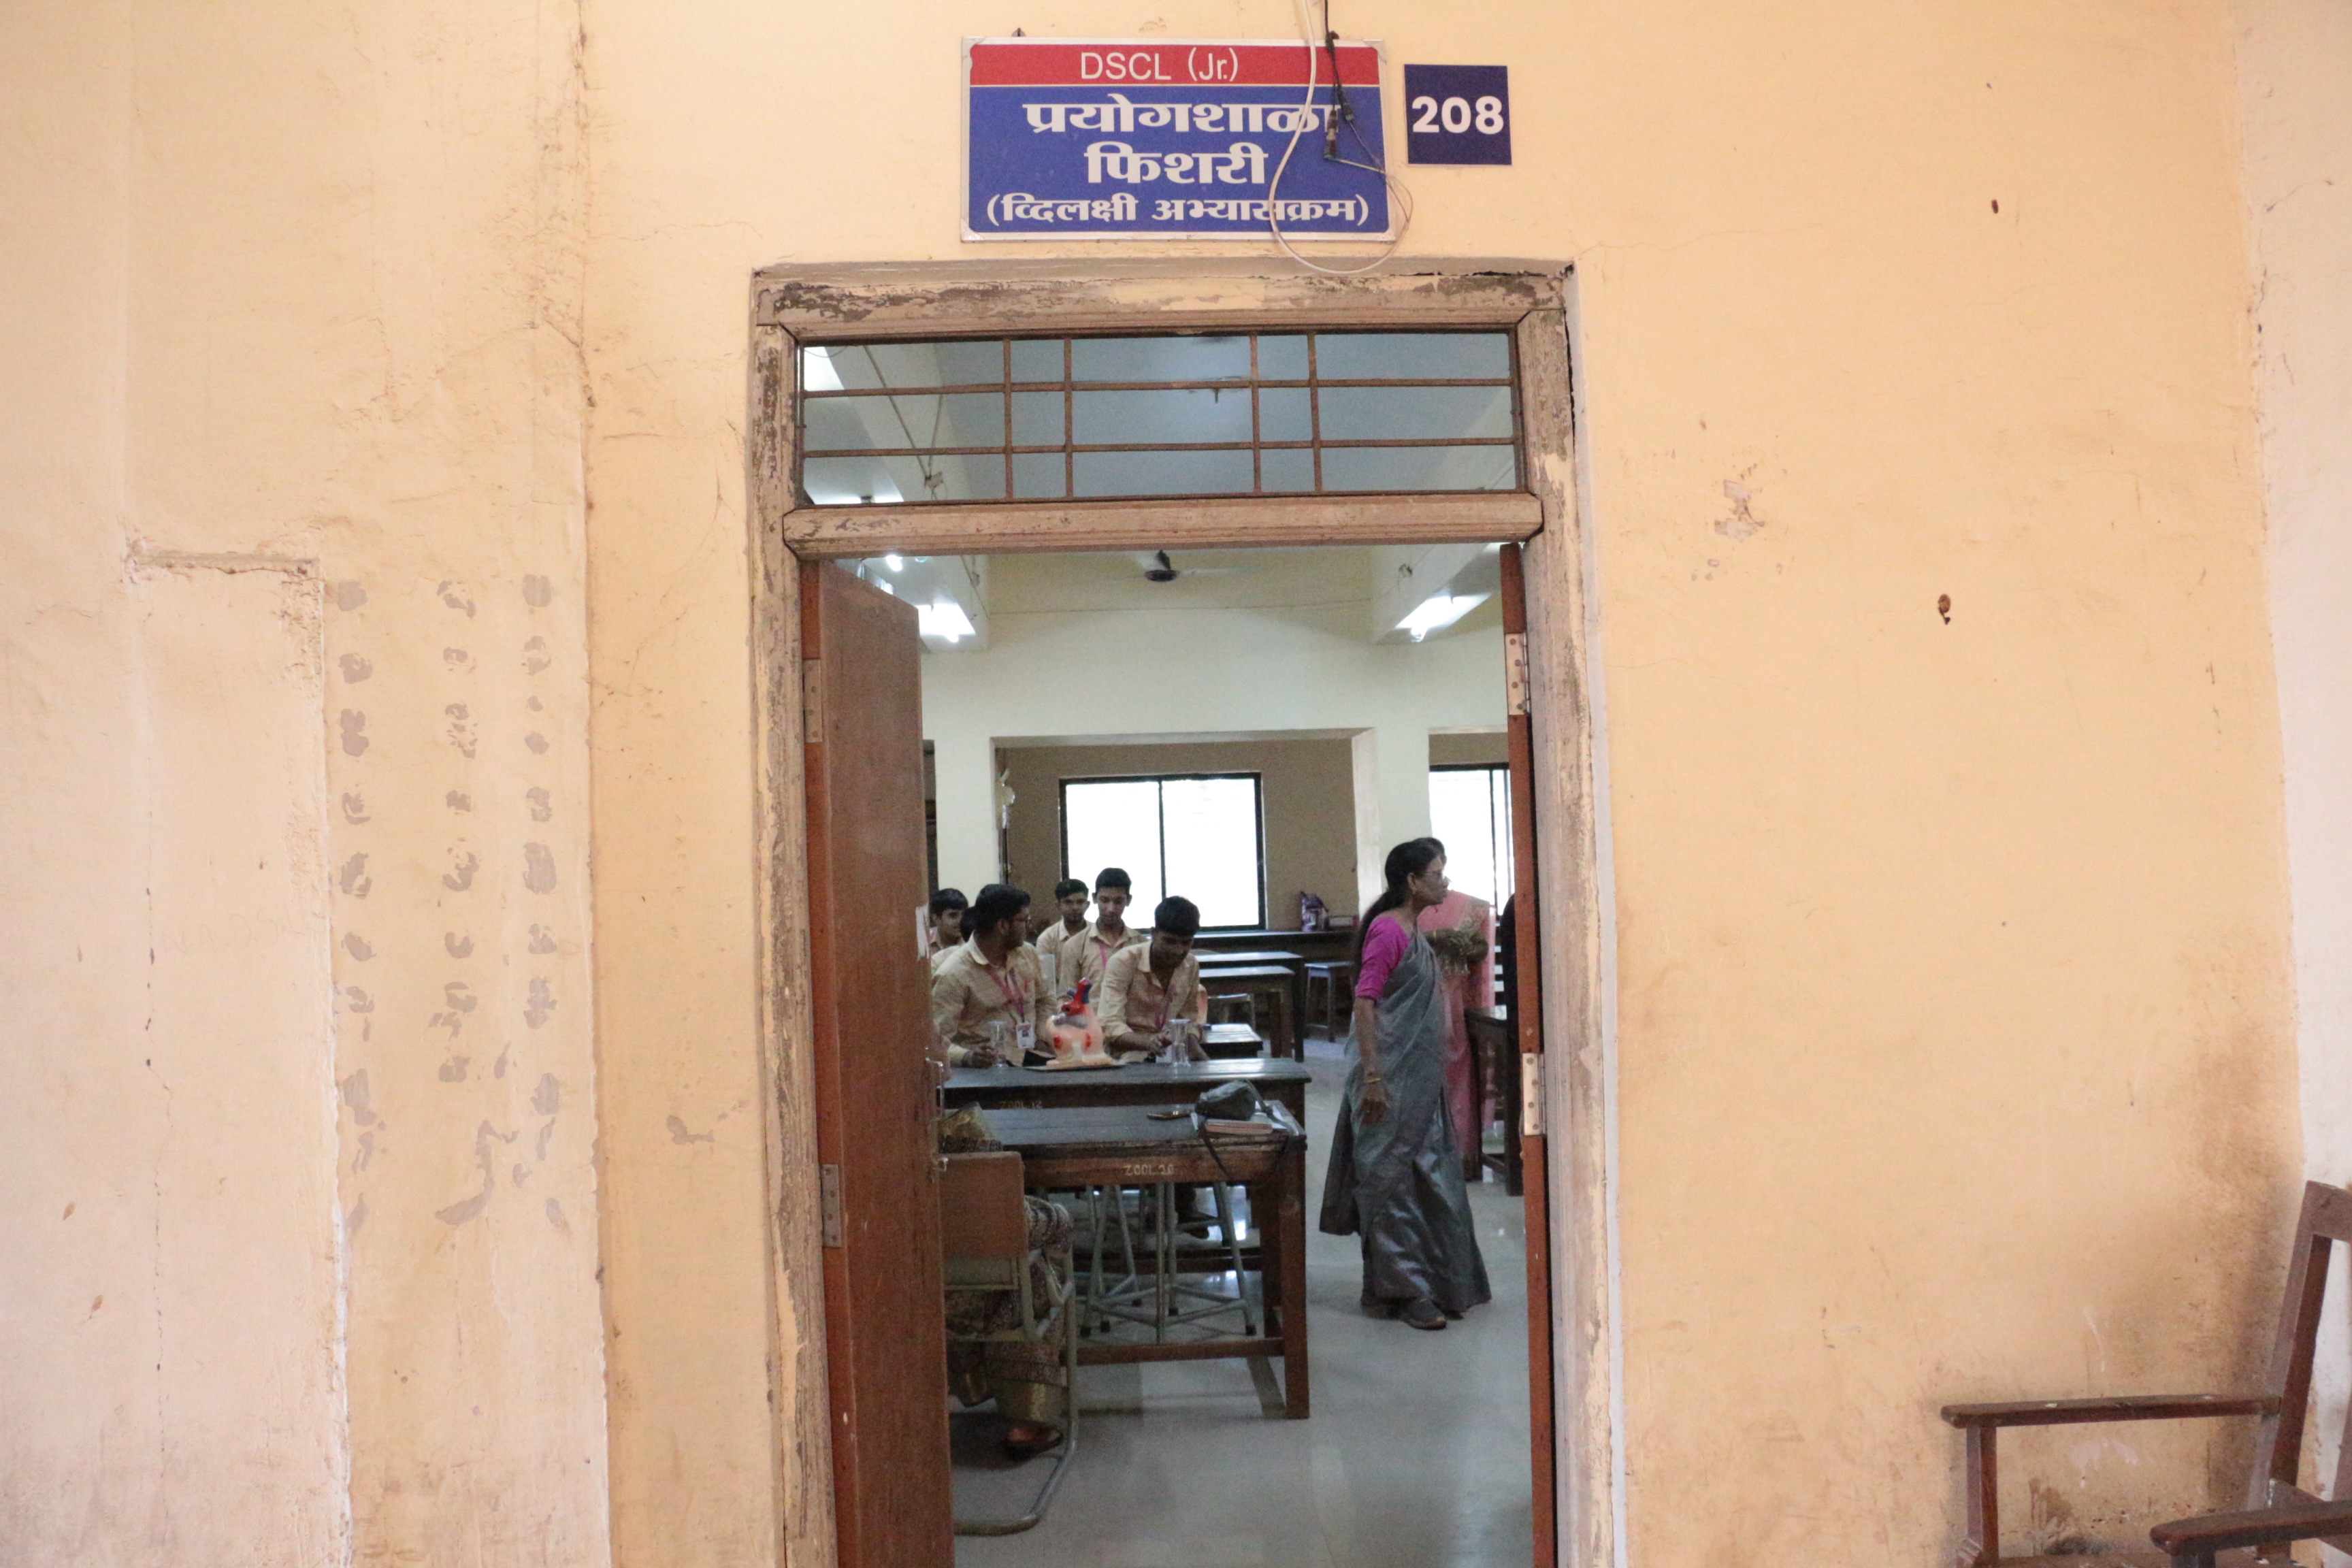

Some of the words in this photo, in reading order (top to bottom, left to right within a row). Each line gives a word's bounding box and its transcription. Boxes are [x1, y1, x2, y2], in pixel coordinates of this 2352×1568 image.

[1081, 52, 1172, 80] DSCL
[1188, 46, 1239, 82] (Jr.)
[1022, 93, 1342, 134] प्रयोगशाळा
[1411, 95, 1505, 135] 208
[1083, 140, 1269, 184] फिशरी
[1151, 193, 1369, 227] अभ्यासक्रम)
